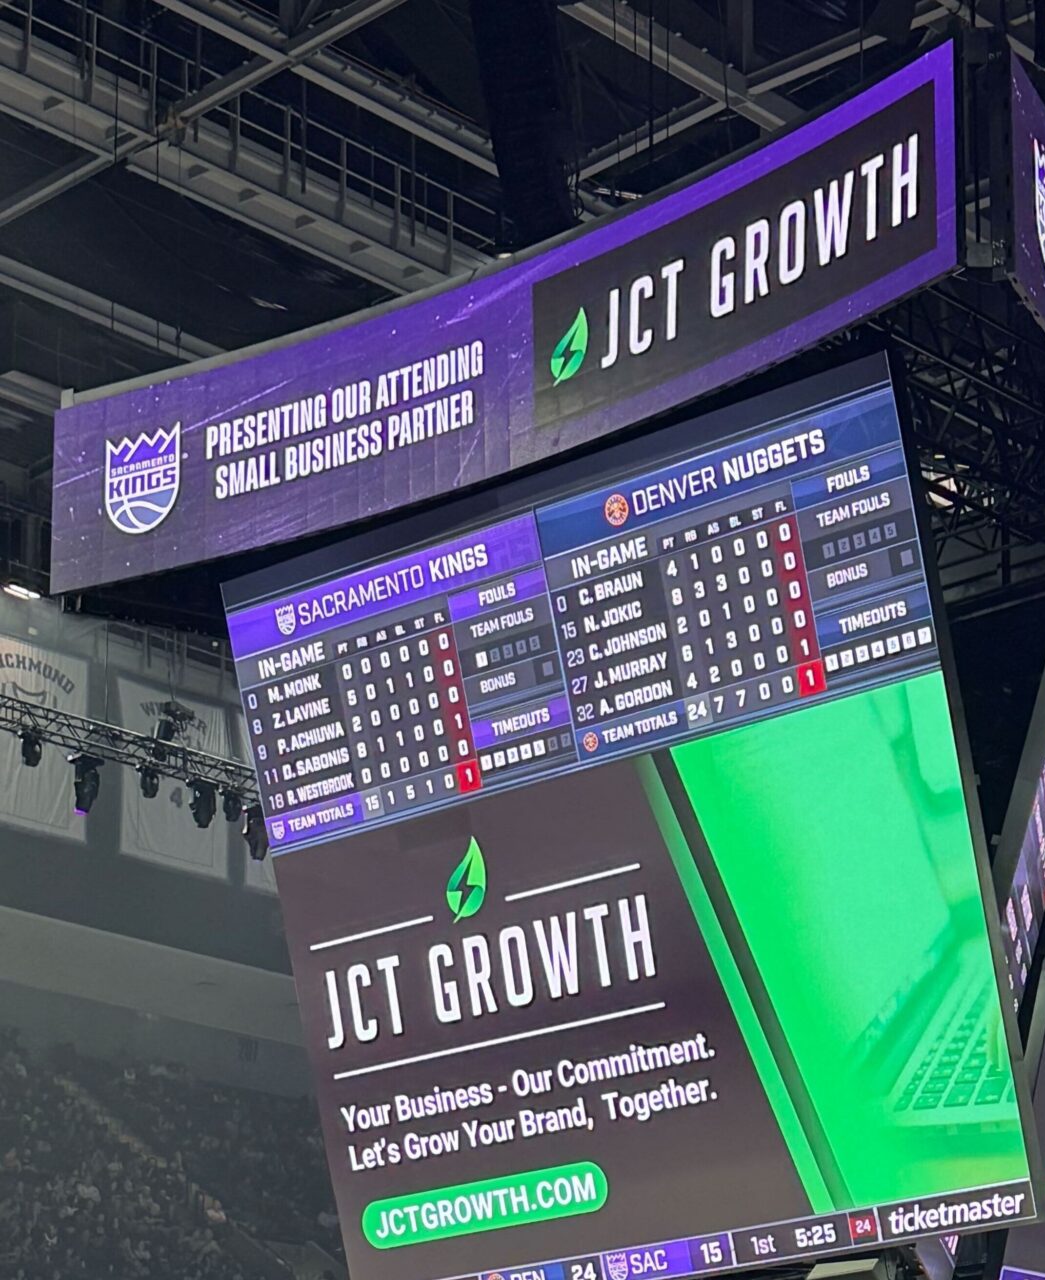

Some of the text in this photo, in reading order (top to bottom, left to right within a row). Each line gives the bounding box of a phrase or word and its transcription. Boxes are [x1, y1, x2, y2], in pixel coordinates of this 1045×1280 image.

[601, 133, 920, 368] JCT GROWTH
[205, 340, 484, 460] PRESENTING OUR ATTENDING
[215, 390, 475, 498] SMALL BUSINESS PARTNER
[108, 467, 180, 500] KINGS
[632, 429, 826, 515] DENVER NUGGETS
[826, 466, 870, 492] FOULS
[816, 493, 890, 527] TEAM FOULS
[572, 537, 648, 578] IN-GAME
[827, 564, 868, 588] BONUS
[298, 543, 488, 625] SACRAMENTO KINGS
[579, 572, 643, 606] C. BRAUN
[584, 601, 642, 633] N. JOKIC
[839, 602, 906, 634] TIMEOUTS
[258, 642, 325, 679] IN-GAME
[589, 622, 667, 660] C. JOHNSON
[594, 652, 667, 689] J. MURRAY
[600, 681, 673, 716] A. GORDON
[603, 702, 707, 744] TEAM TOTALS 24
[325, 894, 657, 1049] JCT GROWTH
[341, 1033, 715, 1132] Your Business Our Commitment.
[348, 1077, 718, 1170] Let's Grow Your Brand, Together.
[376, 1173, 596, 1238] JCTGROWTH.COM
[630, 1250, 668, 1274] SAC
[701, 1243, 722, 1263] 15
[751, 1235, 776, 1254] 1st
[795, 1224, 836, 1248] 5:25
[855, 1219, 871, 1234] 24
[888, 1190, 1024, 1235] ticketmaster
